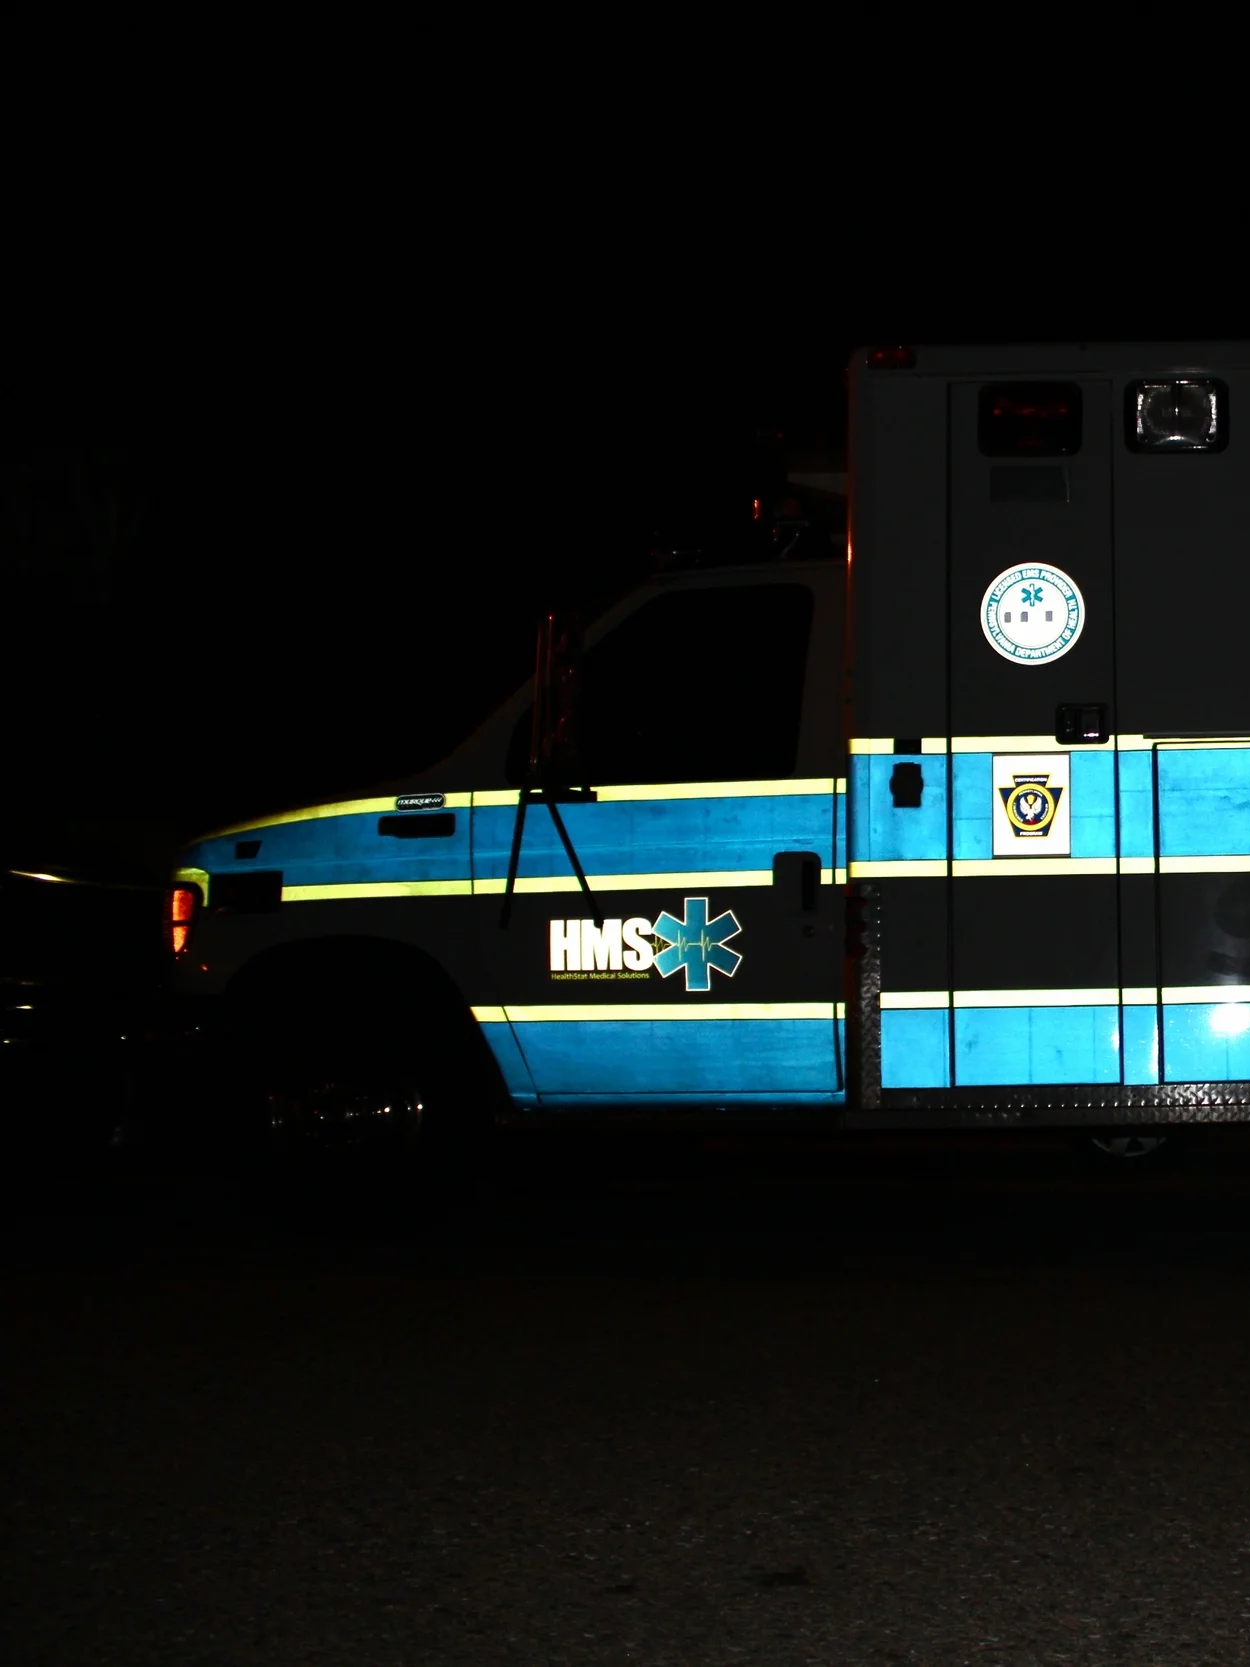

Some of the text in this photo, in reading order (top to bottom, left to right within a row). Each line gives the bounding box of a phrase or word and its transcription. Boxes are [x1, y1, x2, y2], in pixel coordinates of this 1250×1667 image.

[1021, 569, 1040, 579] EMS
[550, 917, 654, 971] HMS
[551, 971, 650, 981] HealthStat Medical Solutions
